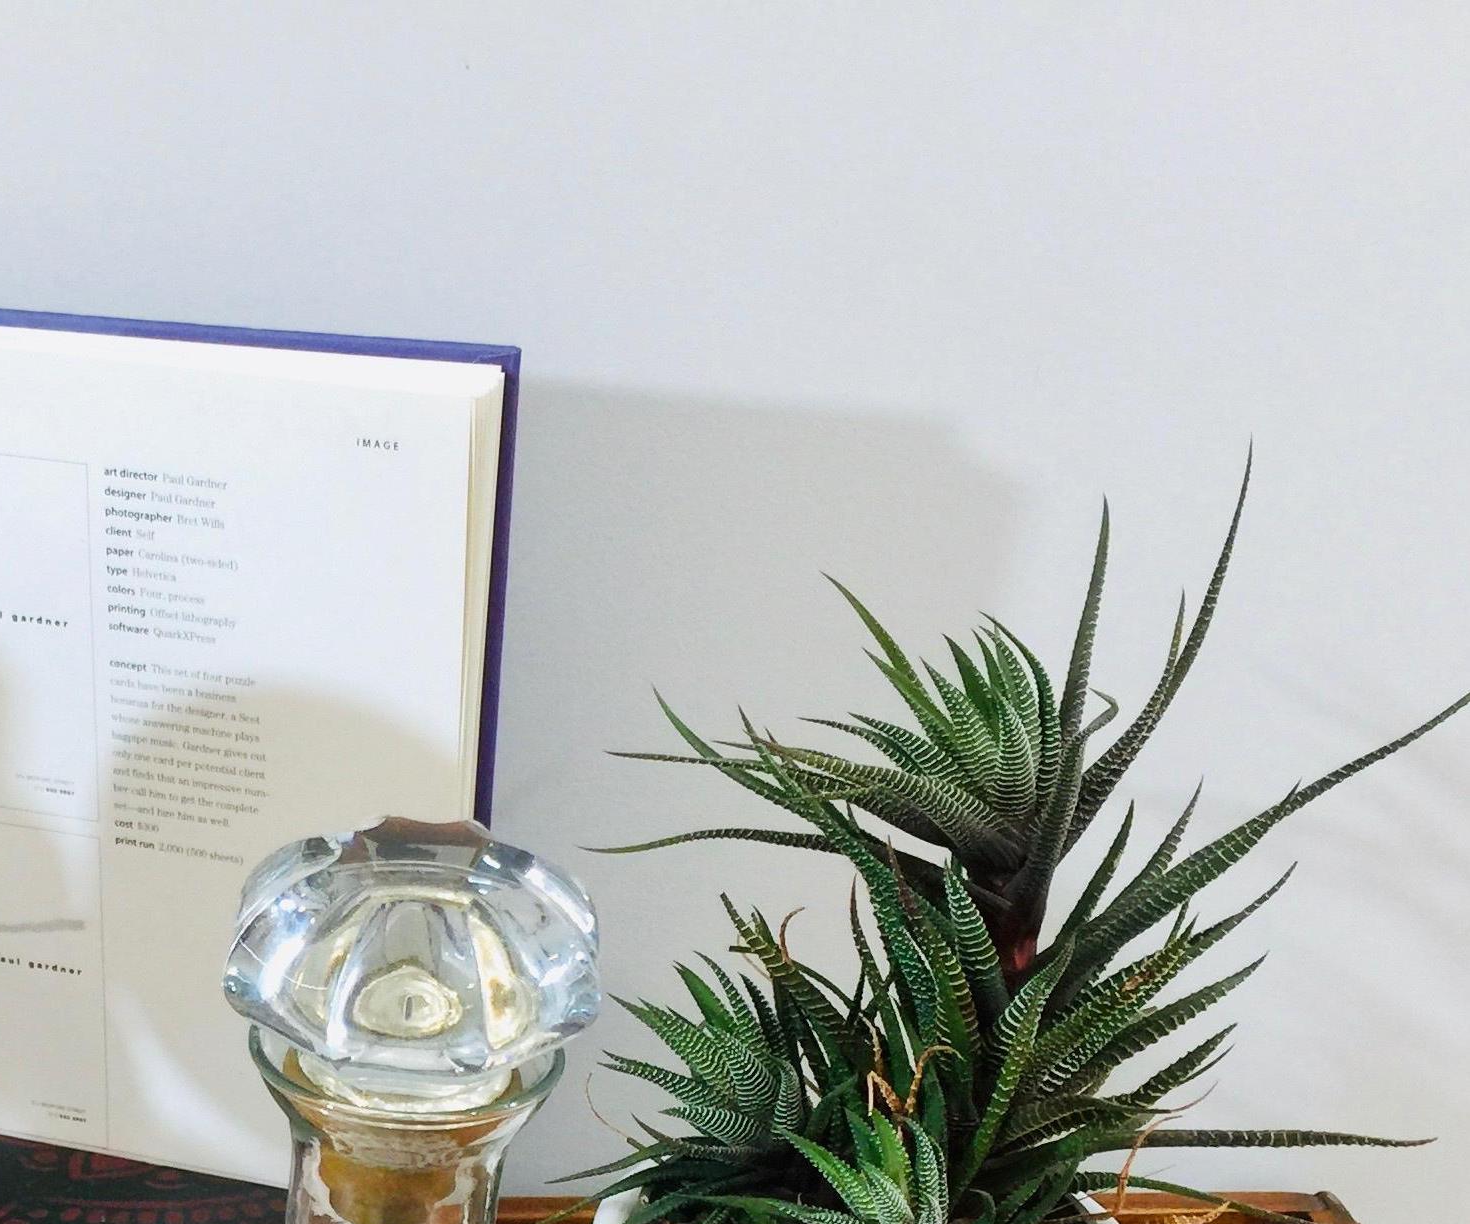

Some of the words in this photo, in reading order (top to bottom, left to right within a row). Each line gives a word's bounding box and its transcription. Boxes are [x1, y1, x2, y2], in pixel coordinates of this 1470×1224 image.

[356, 438, 399, 451] IMAGE
[104, 468, 117, 477] art
[120, 468, 158, 481] director
[162, 473, 184, 485] Paul
[186, 475, 228, 490] Gardner
[104, 486, 147, 501] designer
[151, 491, 172, 503] Paul
[175, 494, 216, 509] Gardner
[105, 506, 172, 523] photographer
[105, 526, 132, 537] client
[106, 546, 134, 557] paper
[138, 548, 179, 563] Carolina
[106, 565, 128, 576] type
[132, 568, 177, 582] Helvetica
[107, 585, 135, 596] colors
[108, 604, 146, 617] printing
[11, 614, 69, 629] gardner
[108, 622, 149, 635] software
[109, 660, 147, 672] concept
[151, 664, 172, 676] This
[167, 701, 182, 713] the
[234, 731, 260, 743] plays
[114, 819, 133, 829] cost
[115, 836, 137, 847] print
[139, 840, 155, 850] run
[28, 960, 83, 977] gardner
